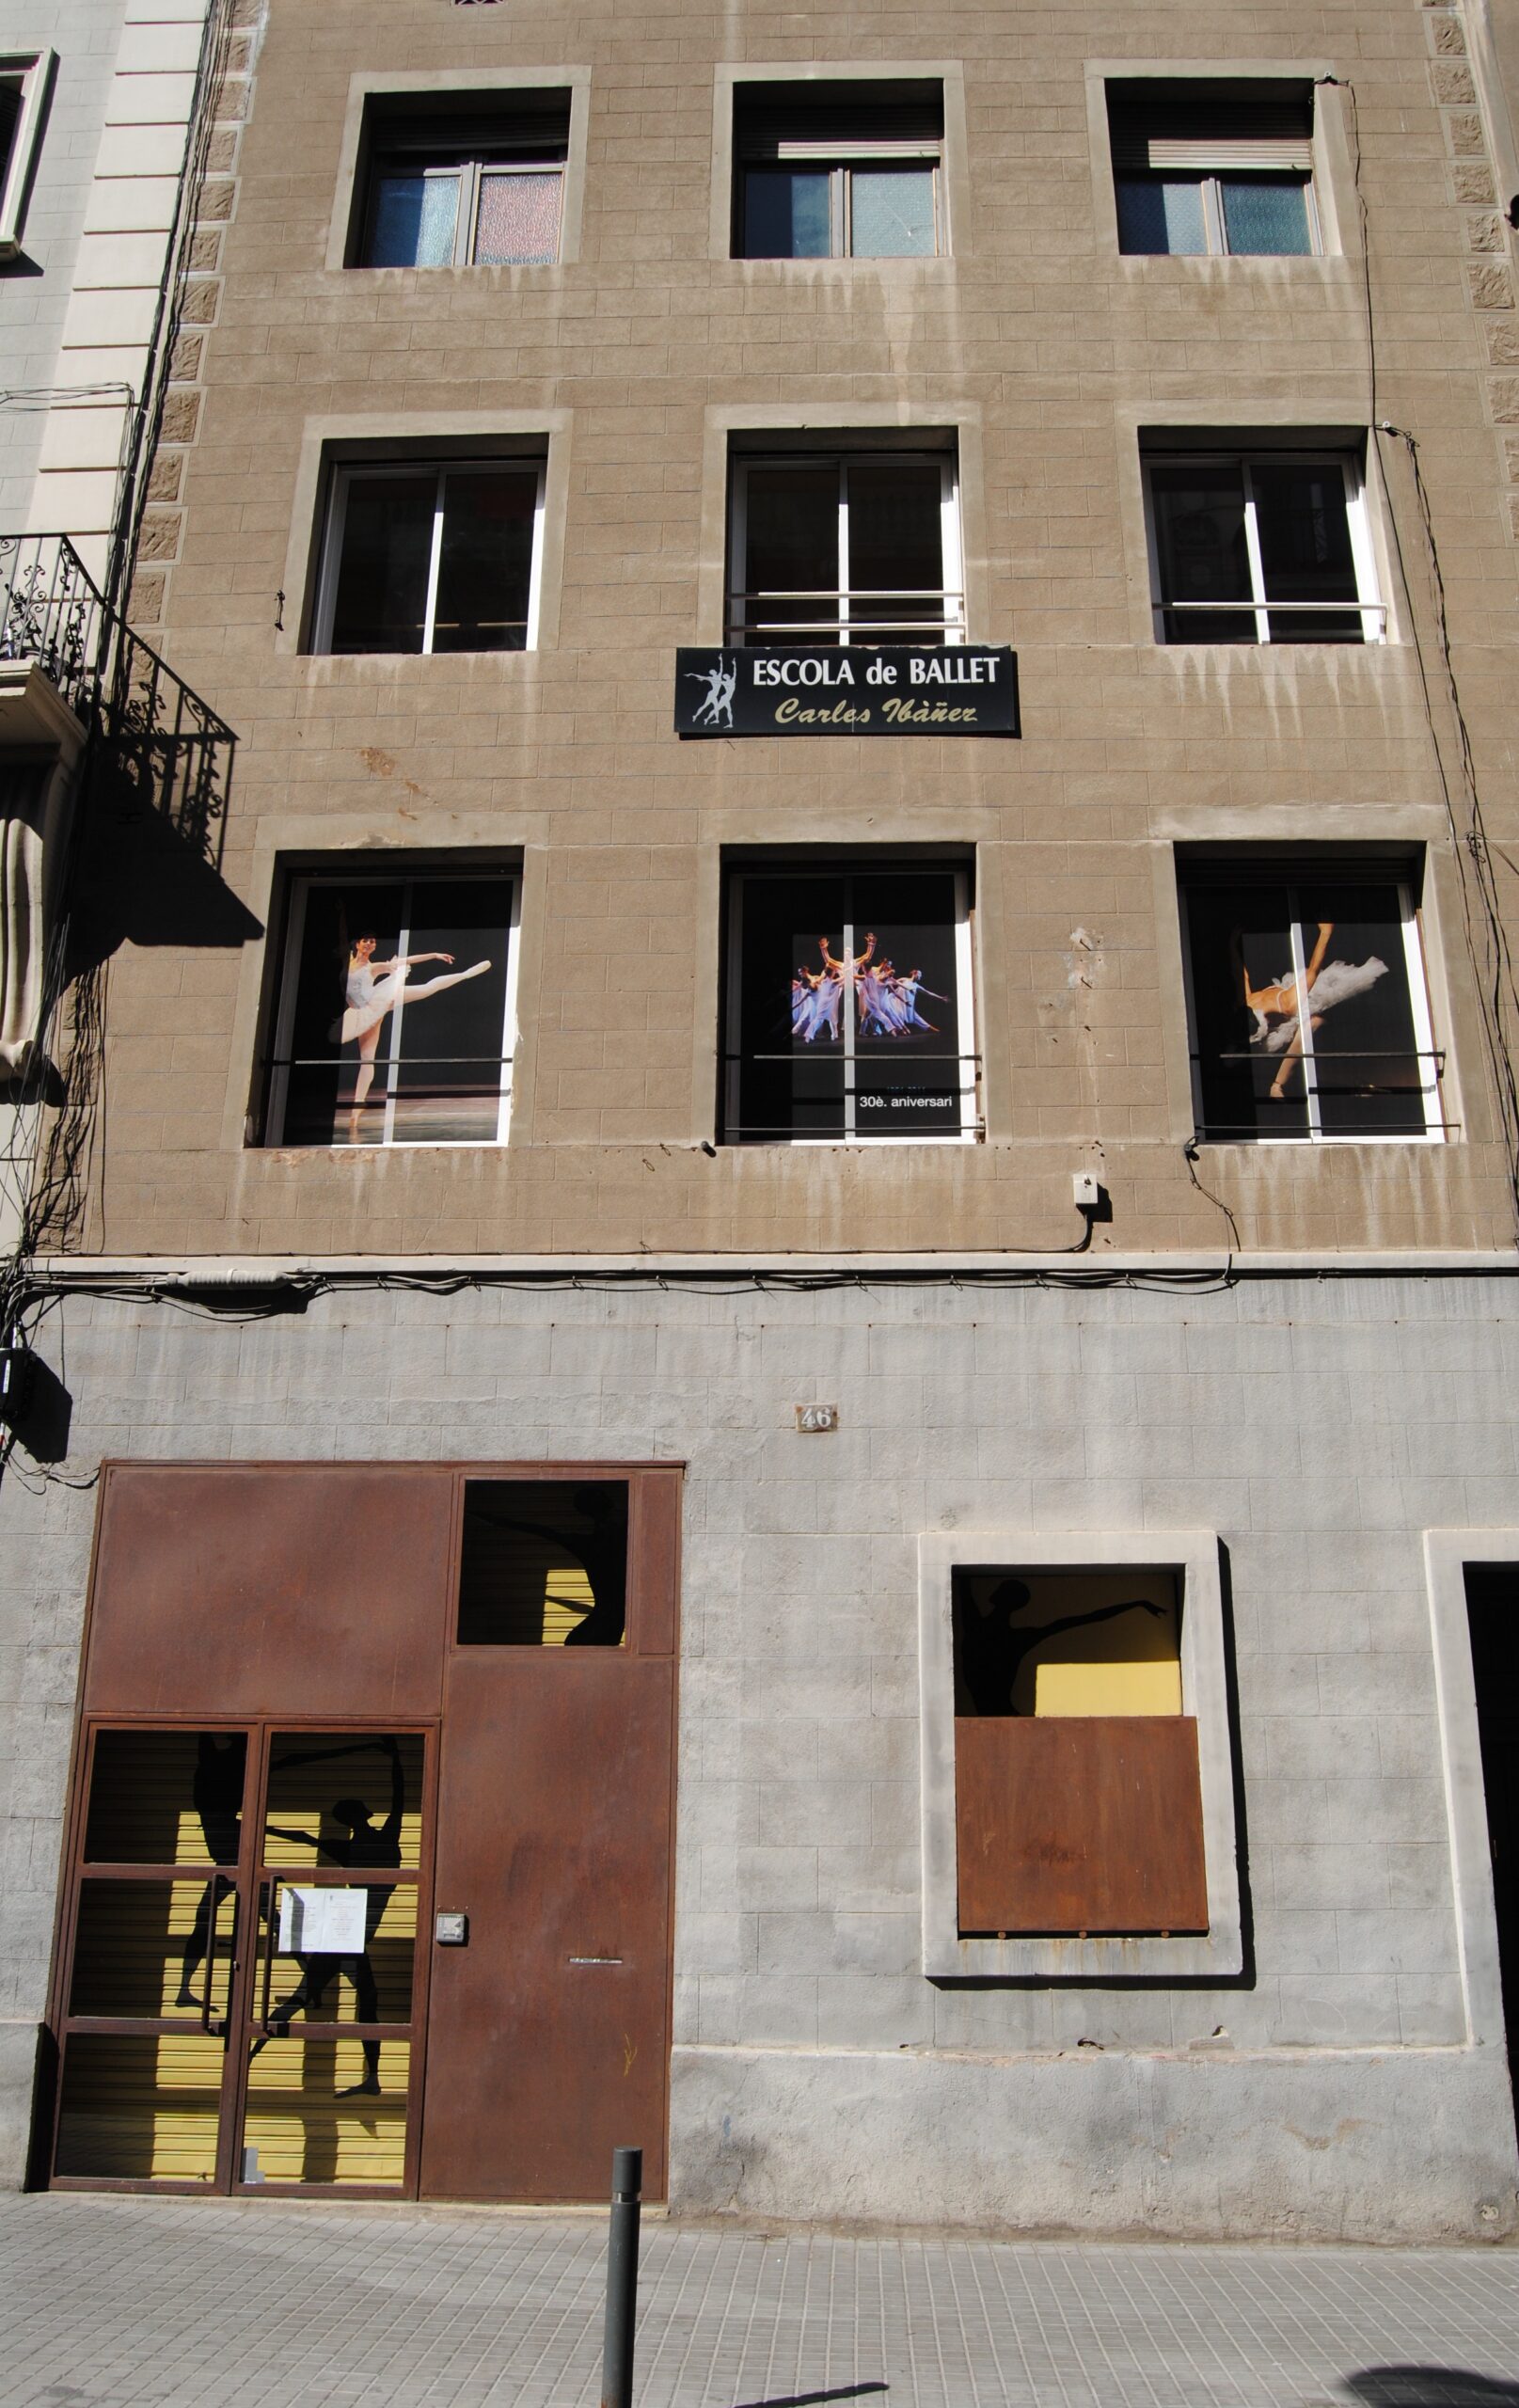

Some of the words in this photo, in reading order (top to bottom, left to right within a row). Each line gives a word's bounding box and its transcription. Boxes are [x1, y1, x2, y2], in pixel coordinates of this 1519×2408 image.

[753, 659, 855, 686] ESCOLA
[866, 658, 896, 685] de
[910, 657, 1000, 684] BALLET
[775, 698, 870, 723] Carles
[891, 1096, 952, 1107] aniversari
[801, 1407, 831, 1428] 46
